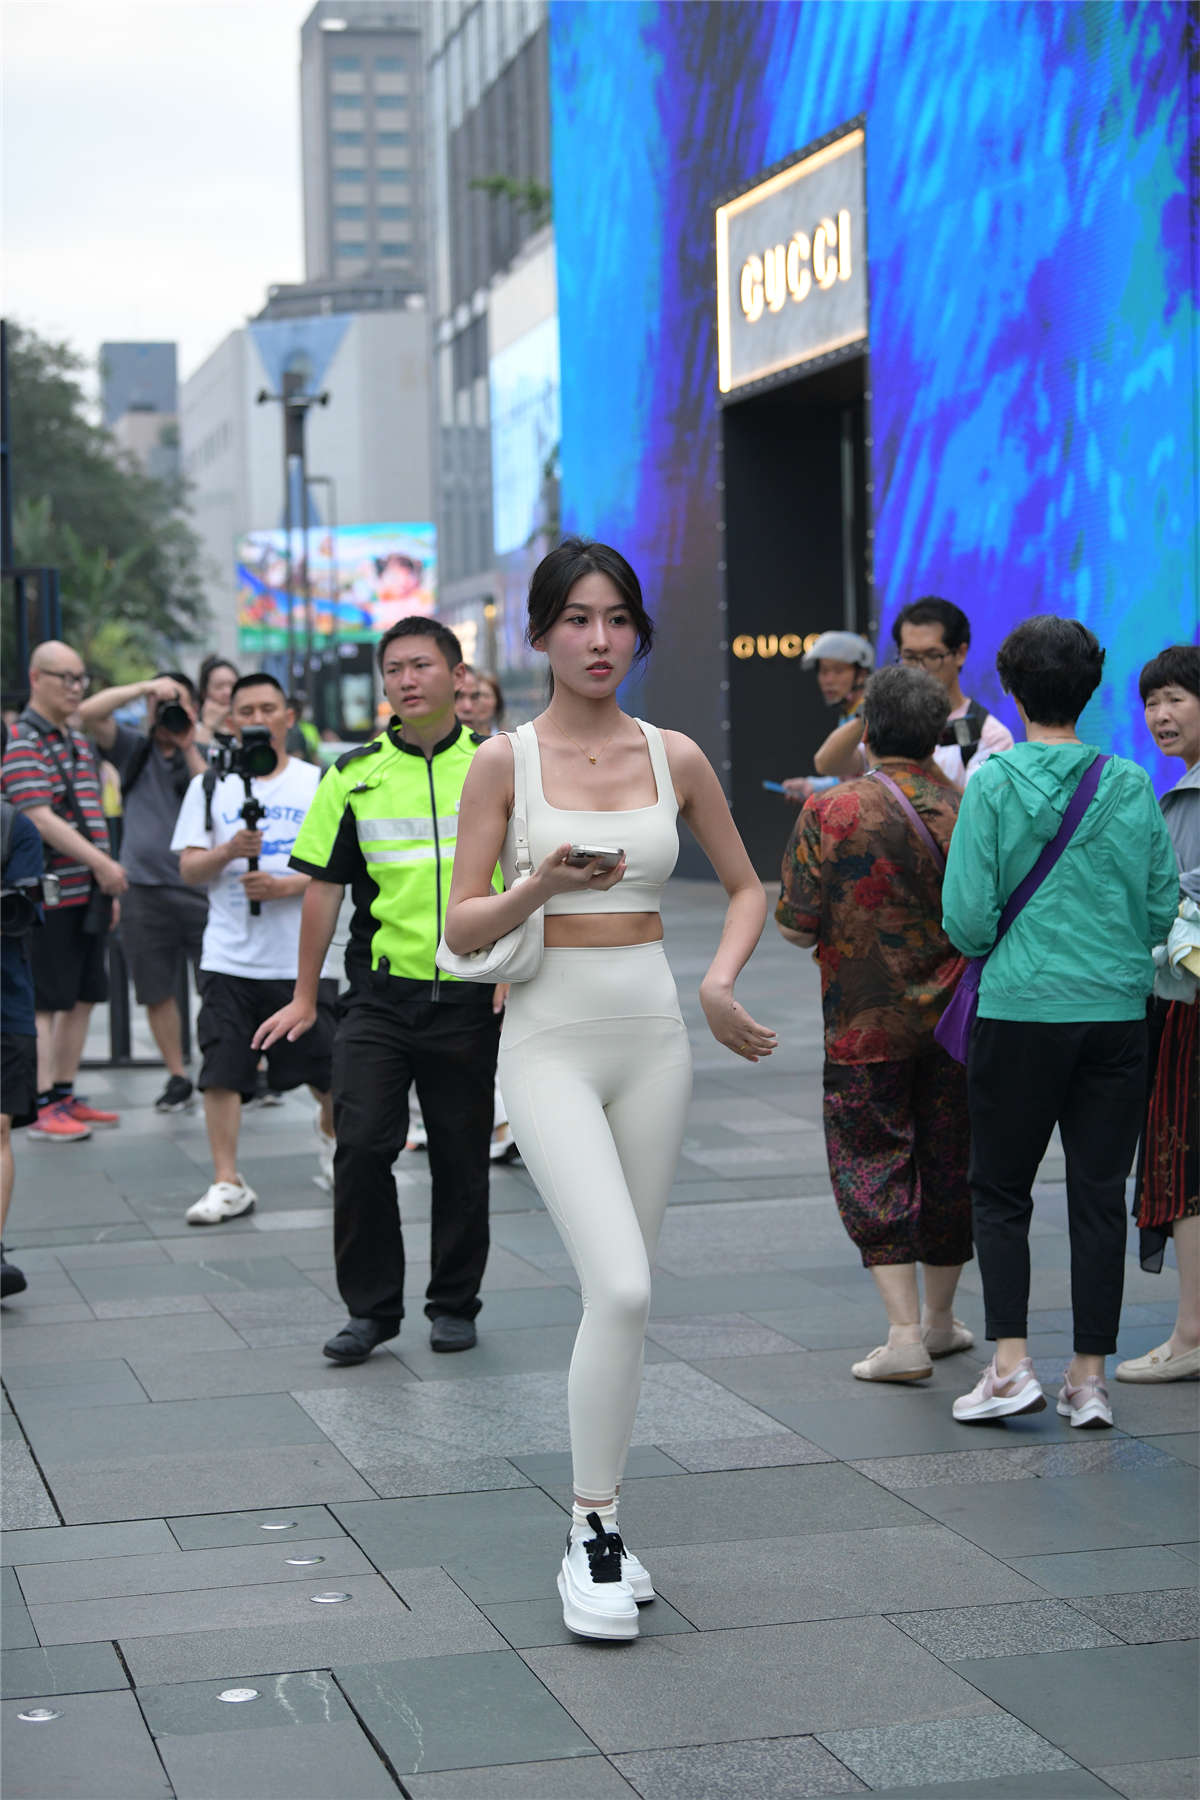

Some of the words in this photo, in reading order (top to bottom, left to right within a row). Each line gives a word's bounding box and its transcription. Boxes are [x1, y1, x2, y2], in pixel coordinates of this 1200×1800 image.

[740, 209, 850, 322] GUCCI
[731, 633, 867, 659] GUC
[222, 804, 304, 825] LSTE
